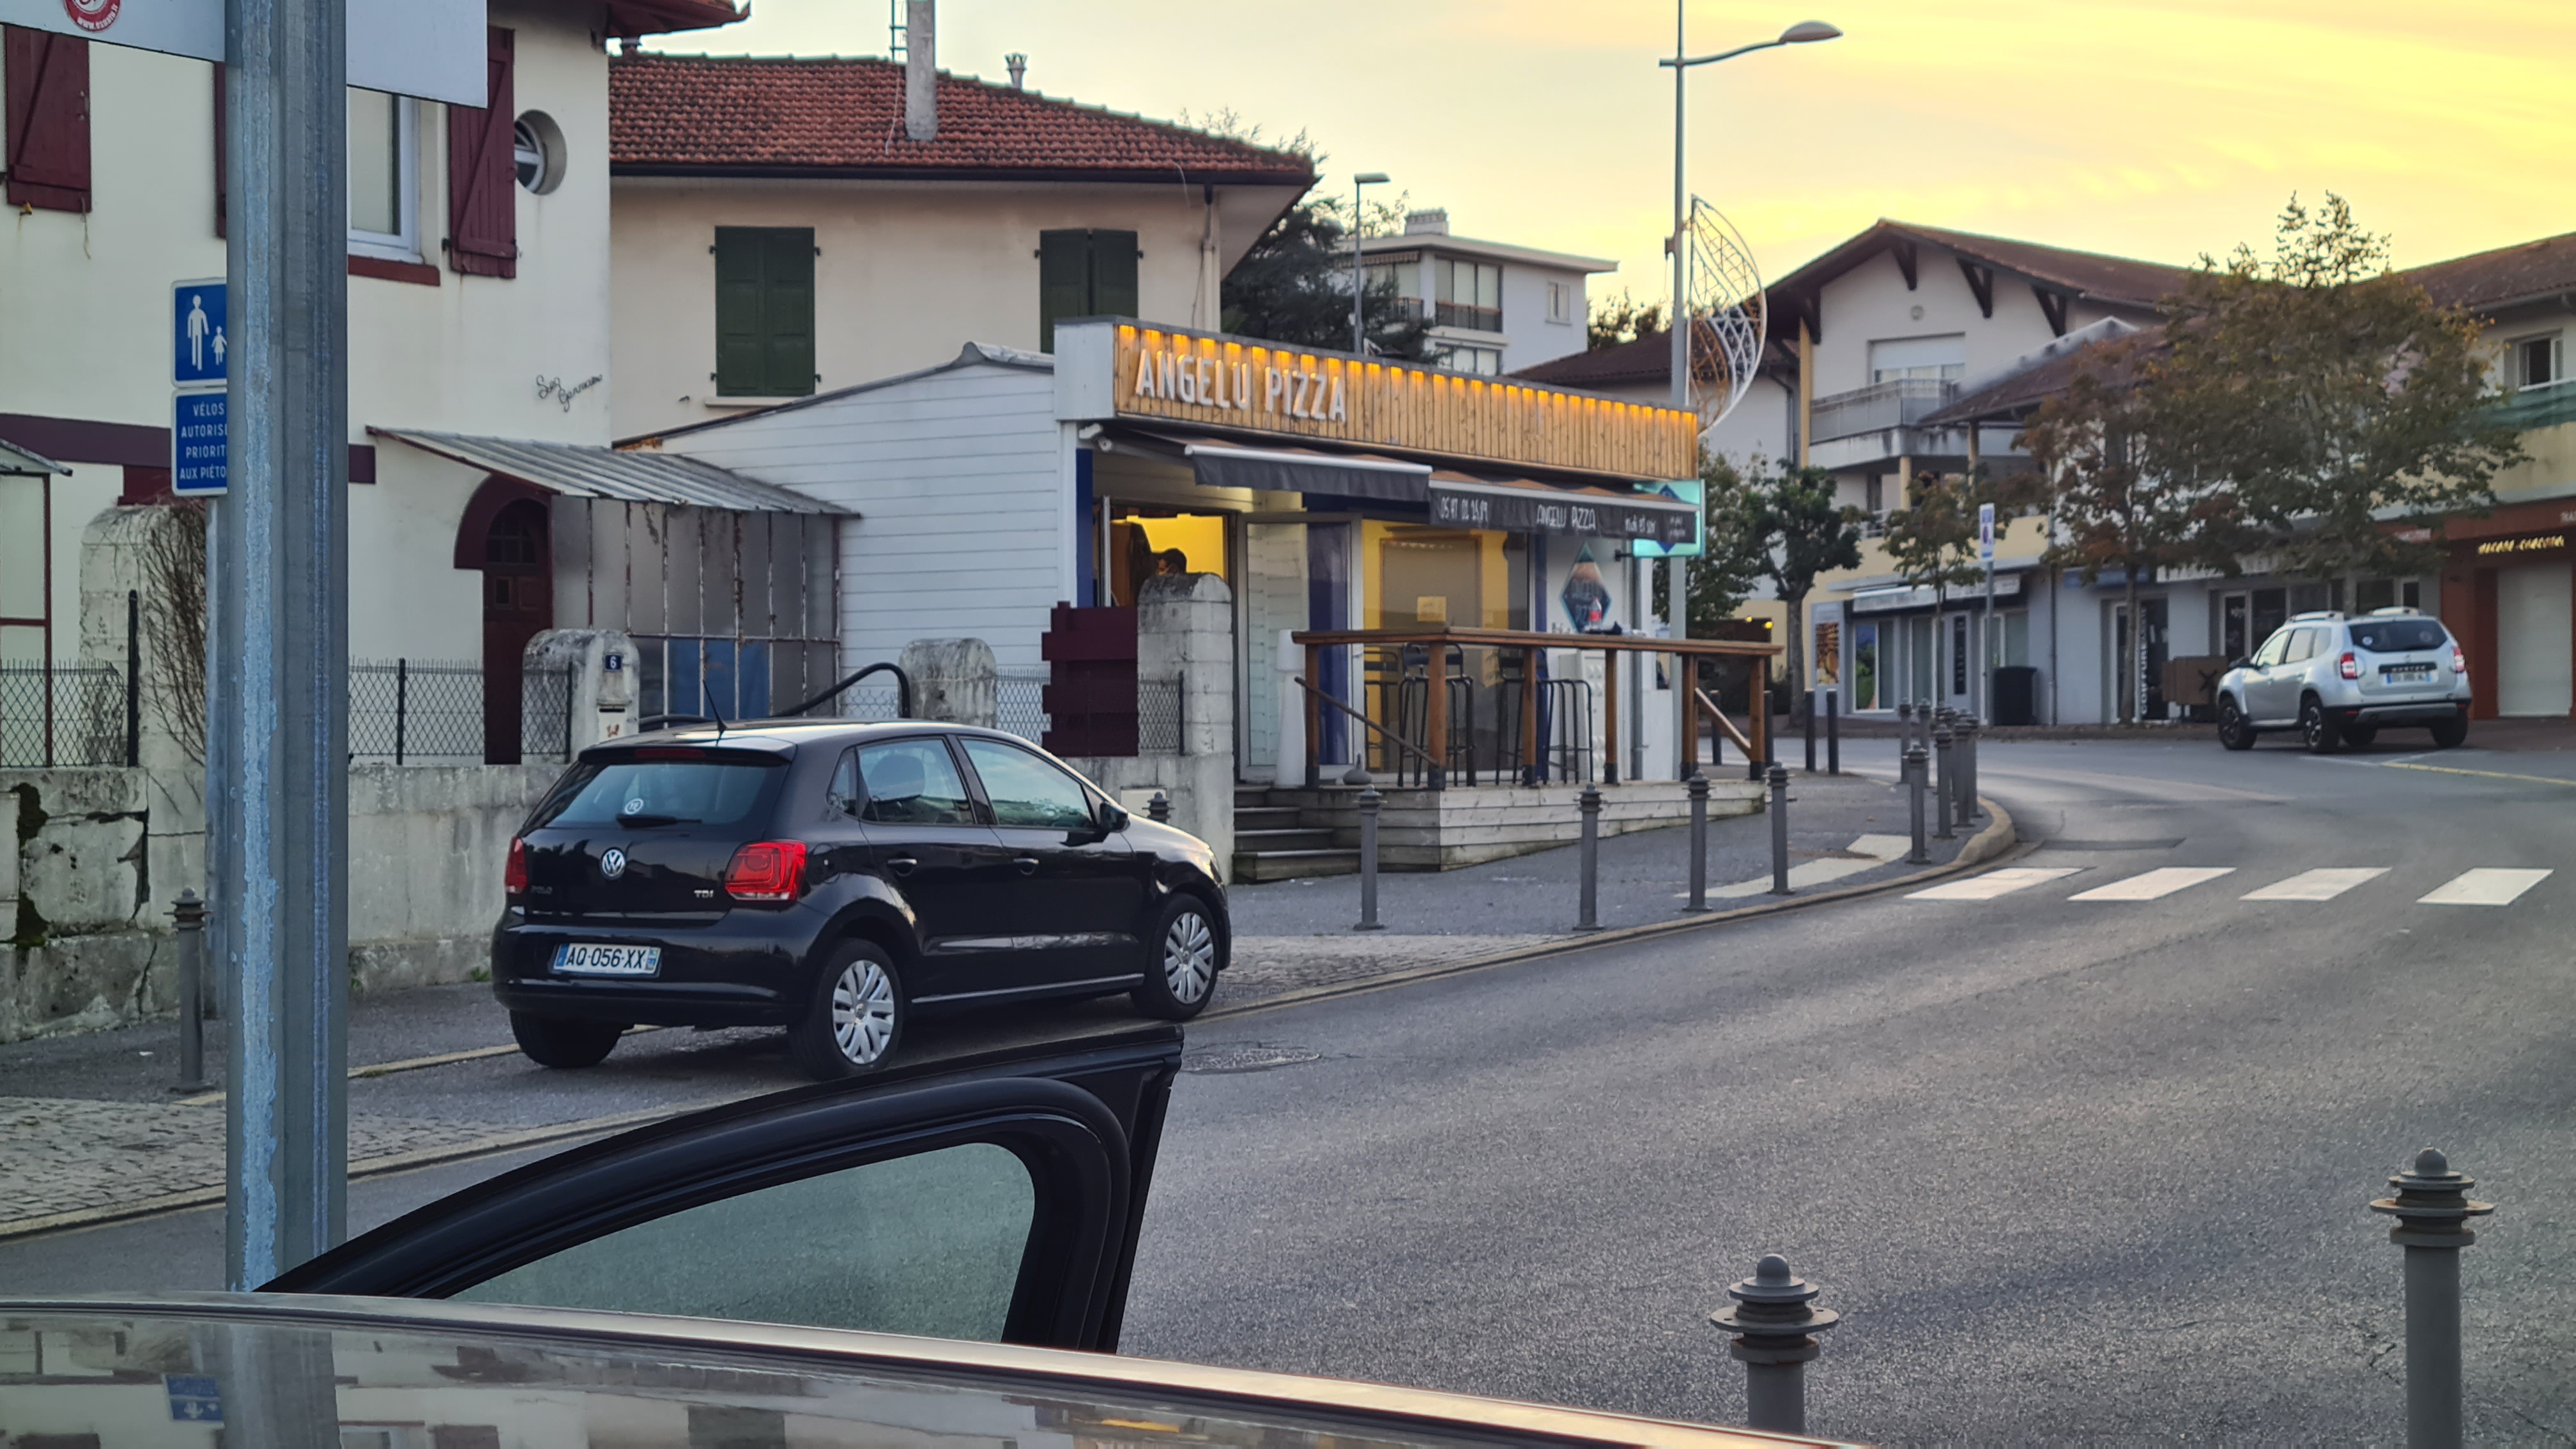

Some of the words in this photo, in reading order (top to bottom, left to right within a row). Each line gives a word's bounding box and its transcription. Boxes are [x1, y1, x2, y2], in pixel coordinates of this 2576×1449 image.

[1135, 348, 1252, 410] ANGELU
[1264, 366, 1346, 423] PIZZA
[192, 401, 225, 417] VÉLOS
[185, 444, 227, 459] PRIORIT
[180, 467, 198, 480] AUX
[200, 463, 227, 479] PIÉTO
[1537, 504, 1567, 528] ANGELU
[1572, 505, 1597, 530] PIZZA
[610, 656, 617, 669] 6
[693, 889, 714, 898] TDI
